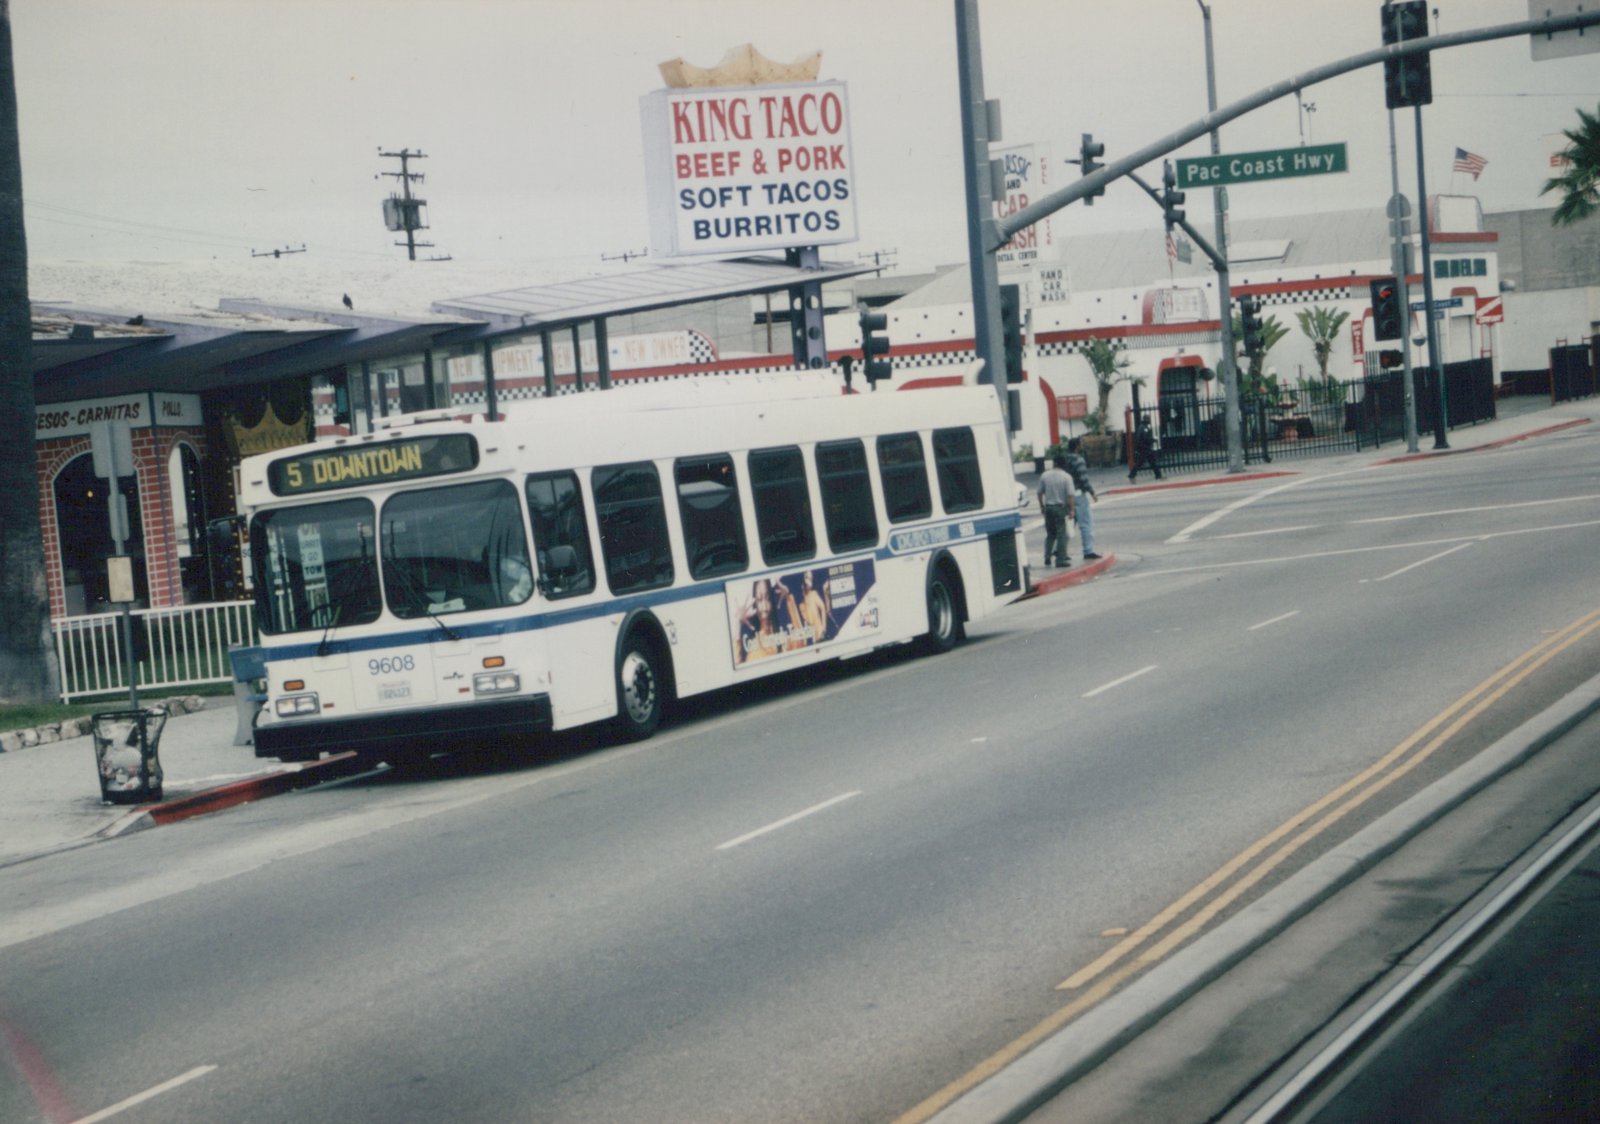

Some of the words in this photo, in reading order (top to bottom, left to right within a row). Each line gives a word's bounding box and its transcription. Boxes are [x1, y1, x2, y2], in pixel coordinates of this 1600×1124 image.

[671, 98, 753, 144] KING
[759, 91, 843, 139] TACO
[676, 151, 741, 179] BEEF
[752, 148, 768, 175] &
[778, 144, 846, 173] PORK
[1187, 164, 1220, 182] Pac
[1230, 155, 1285, 177] Coast
[1294, 152, 1335, 171] Hwy
[680, 185, 752, 210] SOFT
[762, 178, 849, 205] TACOS
[1006, 179, 1021, 190] AND
[693, 209, 841, 240] BURRITOS
[1018, 249, 1038, 260] CENTER
[1040, 269, 1063, 280] HAND
[286, 462, 303, 487] 5
[312, 445, 423, 484] DOWNTOWN
[368, 654, 416, 676] 9608
